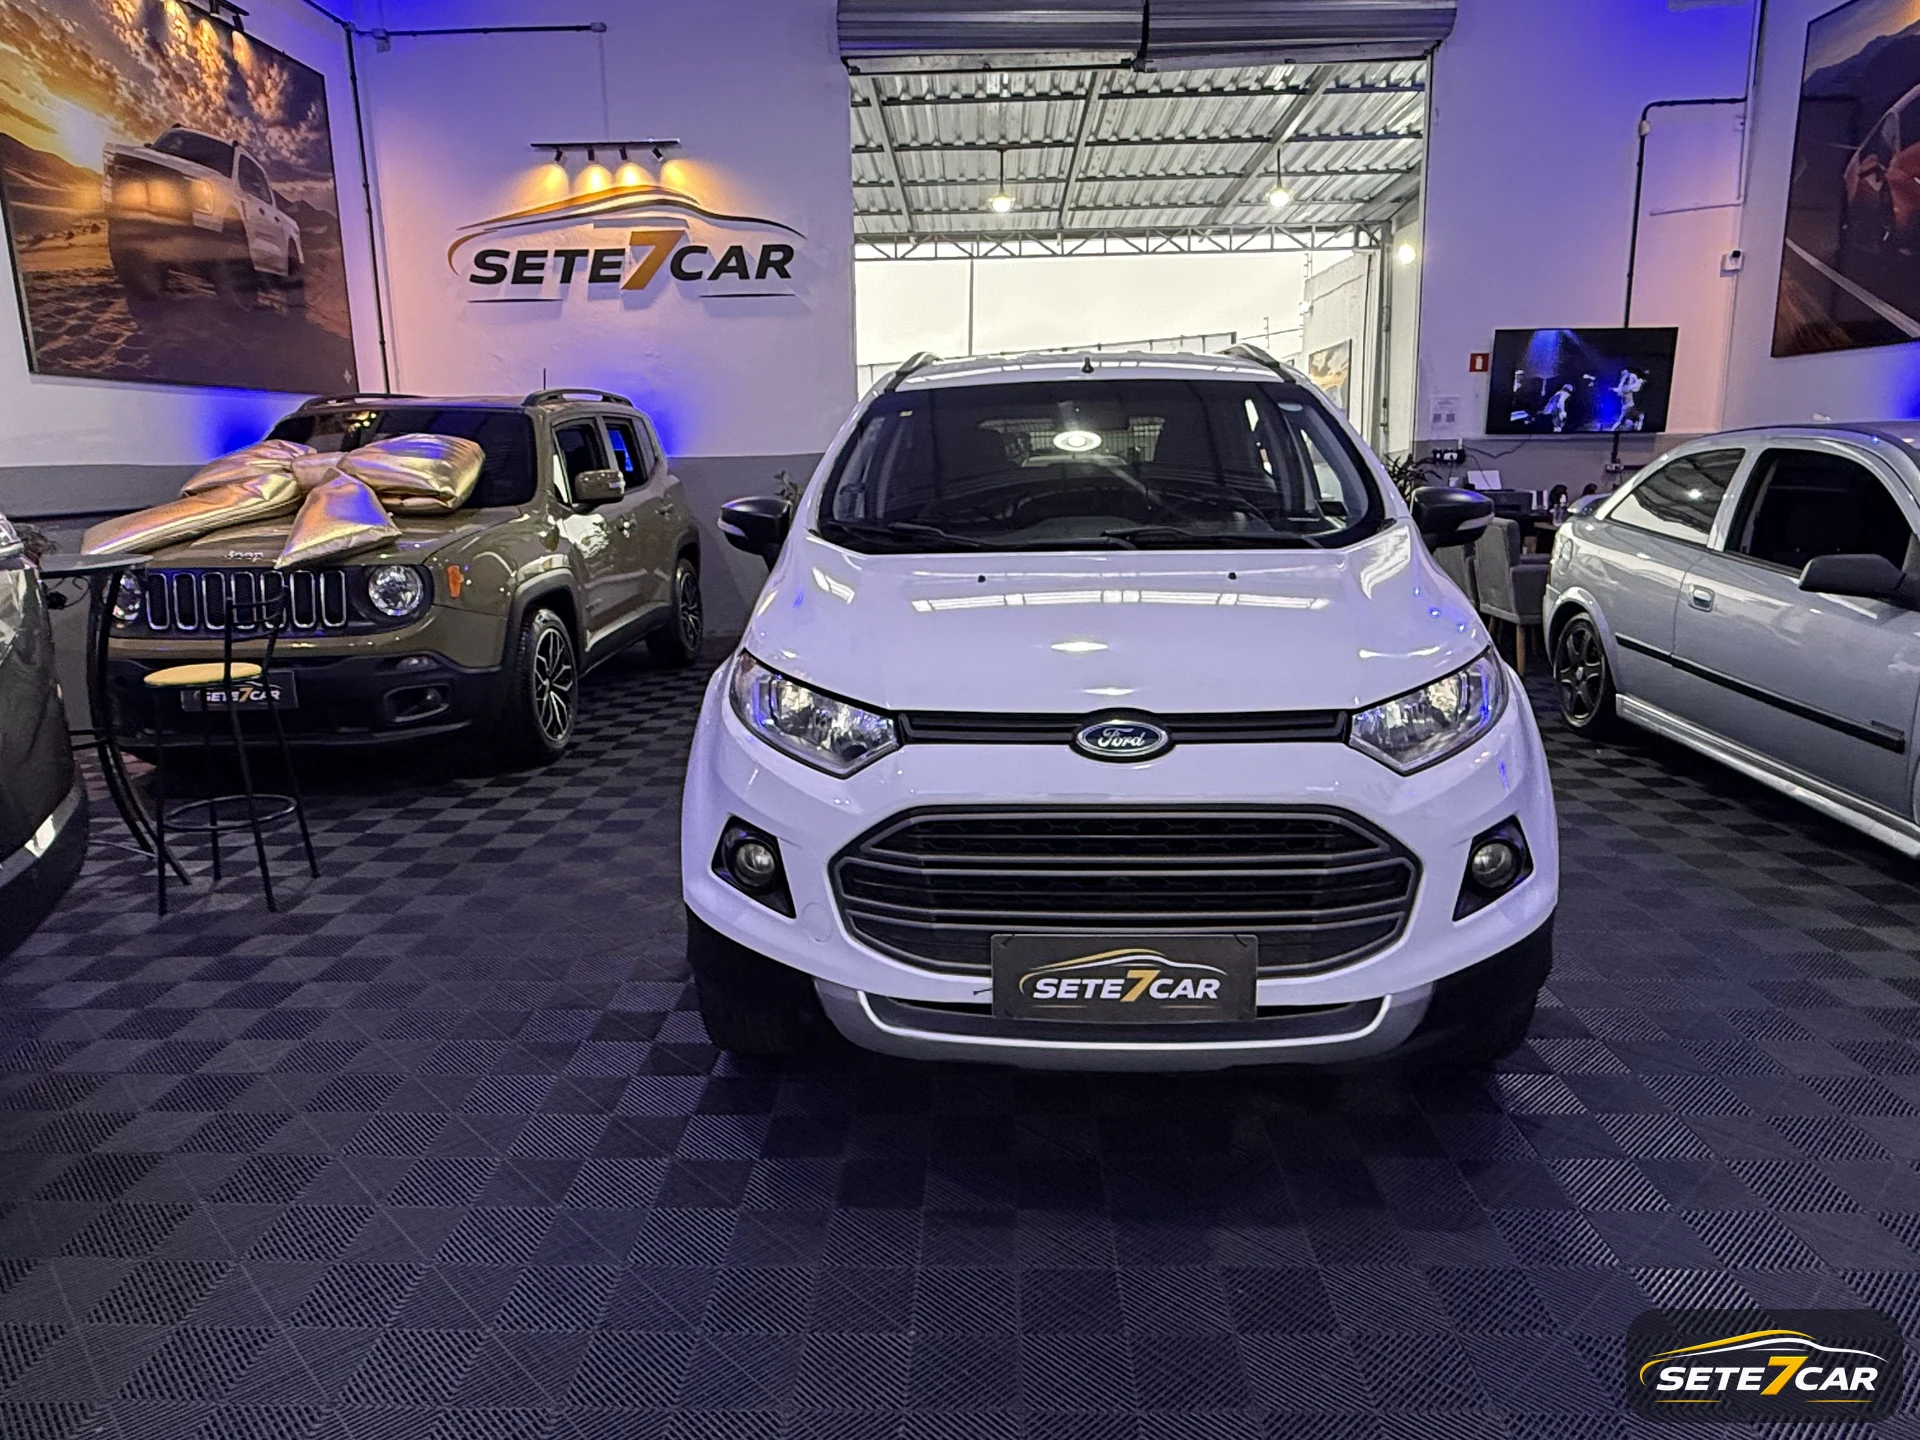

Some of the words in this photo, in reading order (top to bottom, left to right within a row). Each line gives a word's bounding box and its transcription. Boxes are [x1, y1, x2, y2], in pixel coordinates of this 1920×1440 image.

[469, 230, 795, 291] SETE7CAR
[1097, 727, 1146, 748] Ford
[1033, 969, 1221, 1003] SETE7CAR
